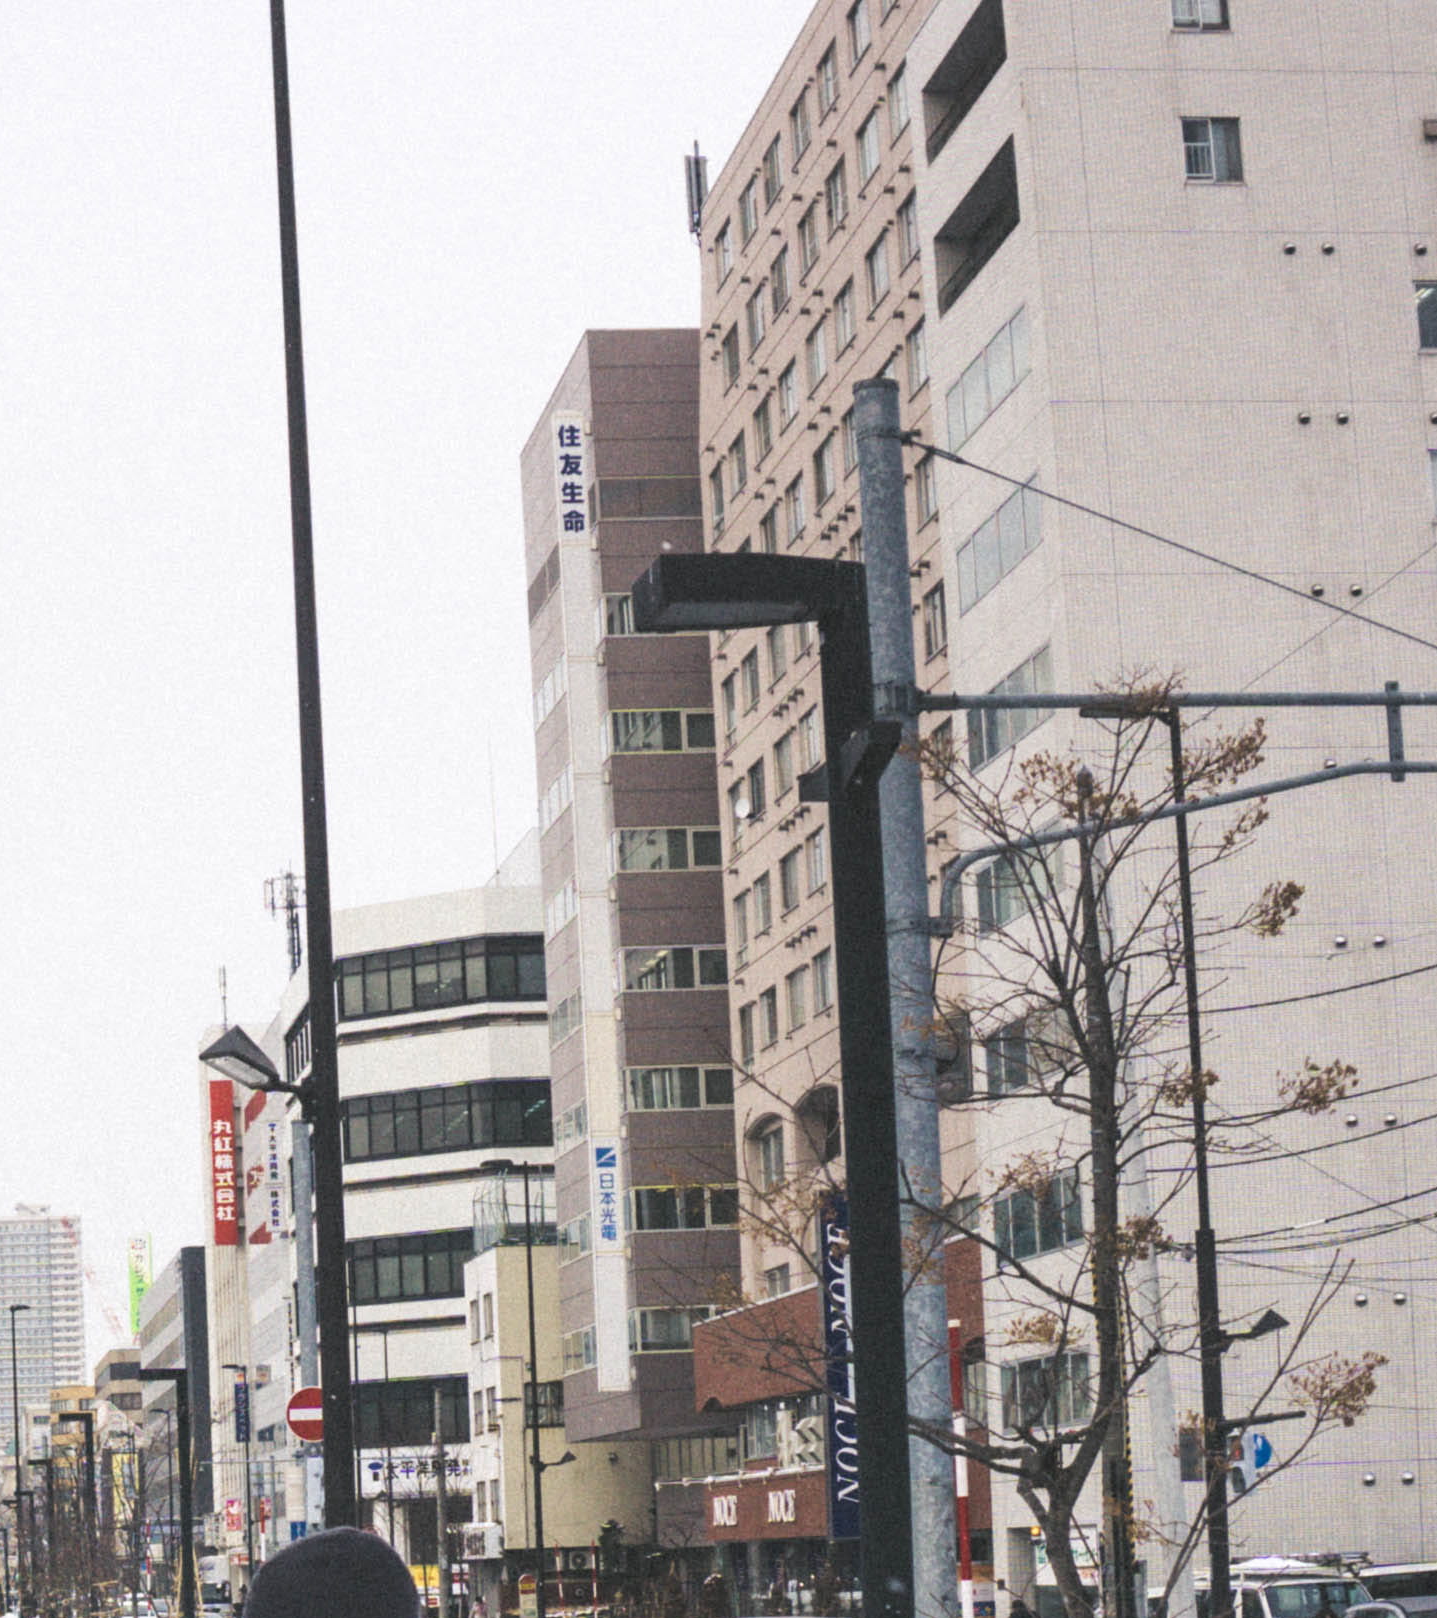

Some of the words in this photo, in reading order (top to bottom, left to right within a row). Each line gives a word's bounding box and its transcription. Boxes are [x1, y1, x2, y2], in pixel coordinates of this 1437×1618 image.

[558, 425, 585, 532] 住友生命
[213, 1119, 237, 1222] 丸紅株式会社
[600, 1173, 618, 1241] 日本光電
[712, 1495, 738, 1526] NOCE
[768, 1489, 796, 1523] NOCE
